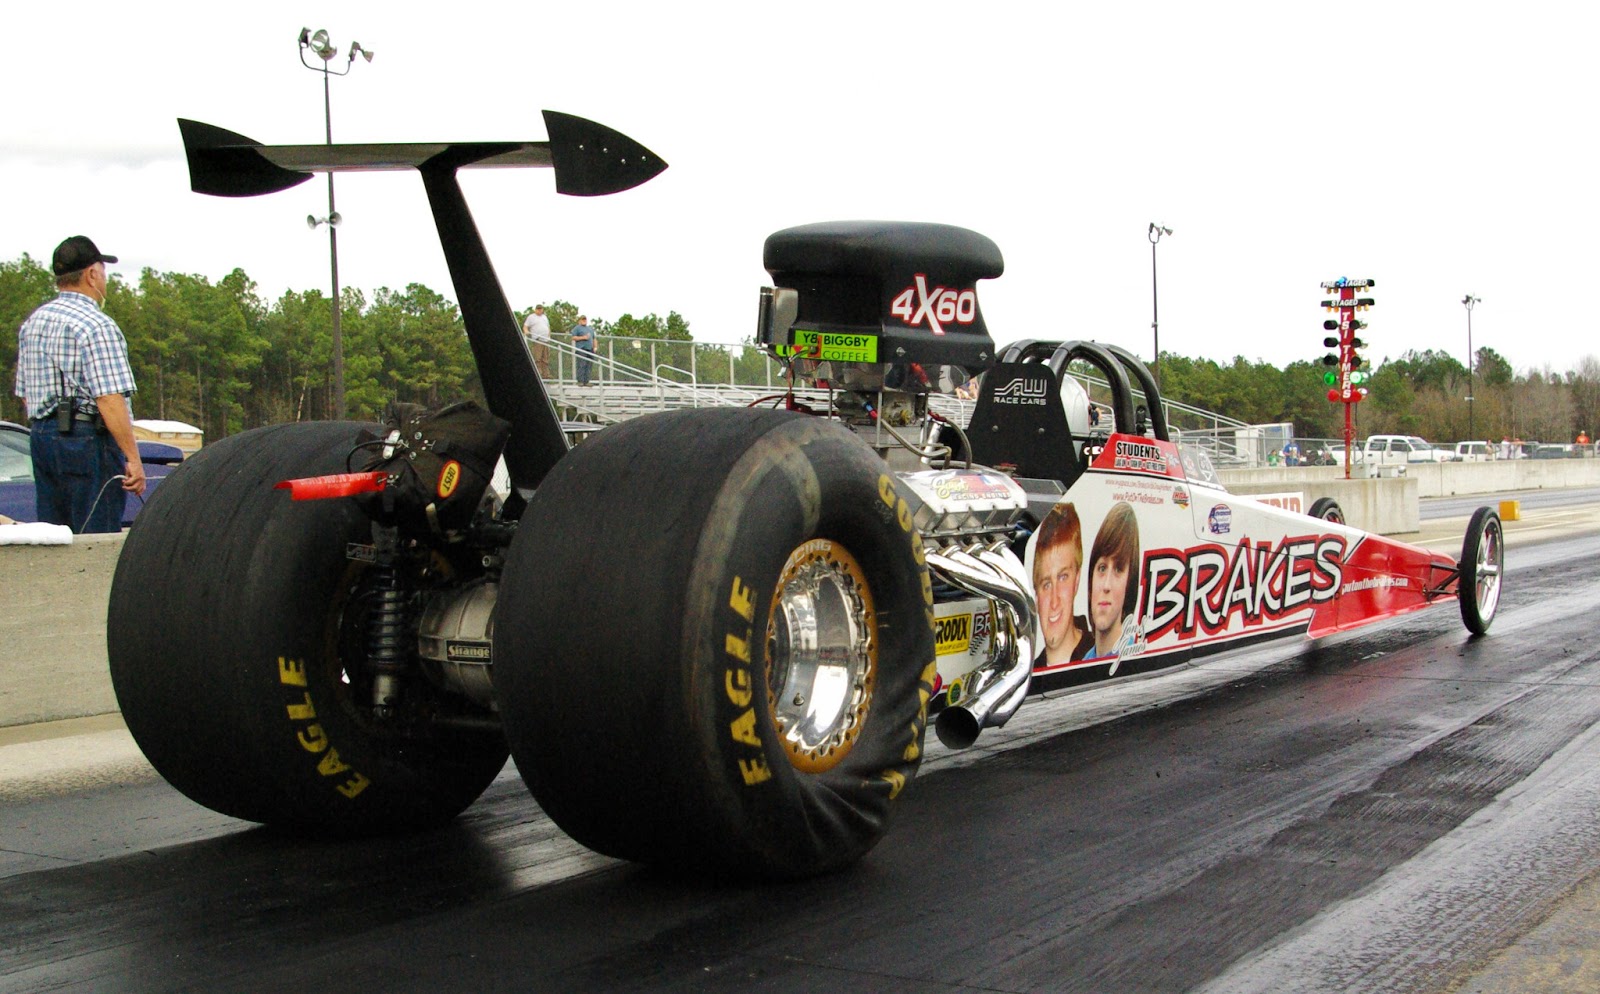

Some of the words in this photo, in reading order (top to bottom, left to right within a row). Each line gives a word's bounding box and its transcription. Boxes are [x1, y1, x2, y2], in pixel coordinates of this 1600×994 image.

[890, 273, 976, 336] 4X60
[1331, 299, 1358, 307] STAGED
[823, 335, 869, 347] BIGGBY
[1342, 312, 1350, 339] TSI
[822, 350, 868, 362] COFFEE
[1342, 345, 1351, 399] TIMERS
[993, 396, 1018, 404] RACE
[1020, 397, 1046, 405] CARS
[1142, 537, 1347, 637] BRAKES
[447, 645, 490, 658] Strange
[1109, 638, 1148, 677] James
[725, 576, 772, 787] EAGLE
[278, 656, 372, 799] EAGLE
